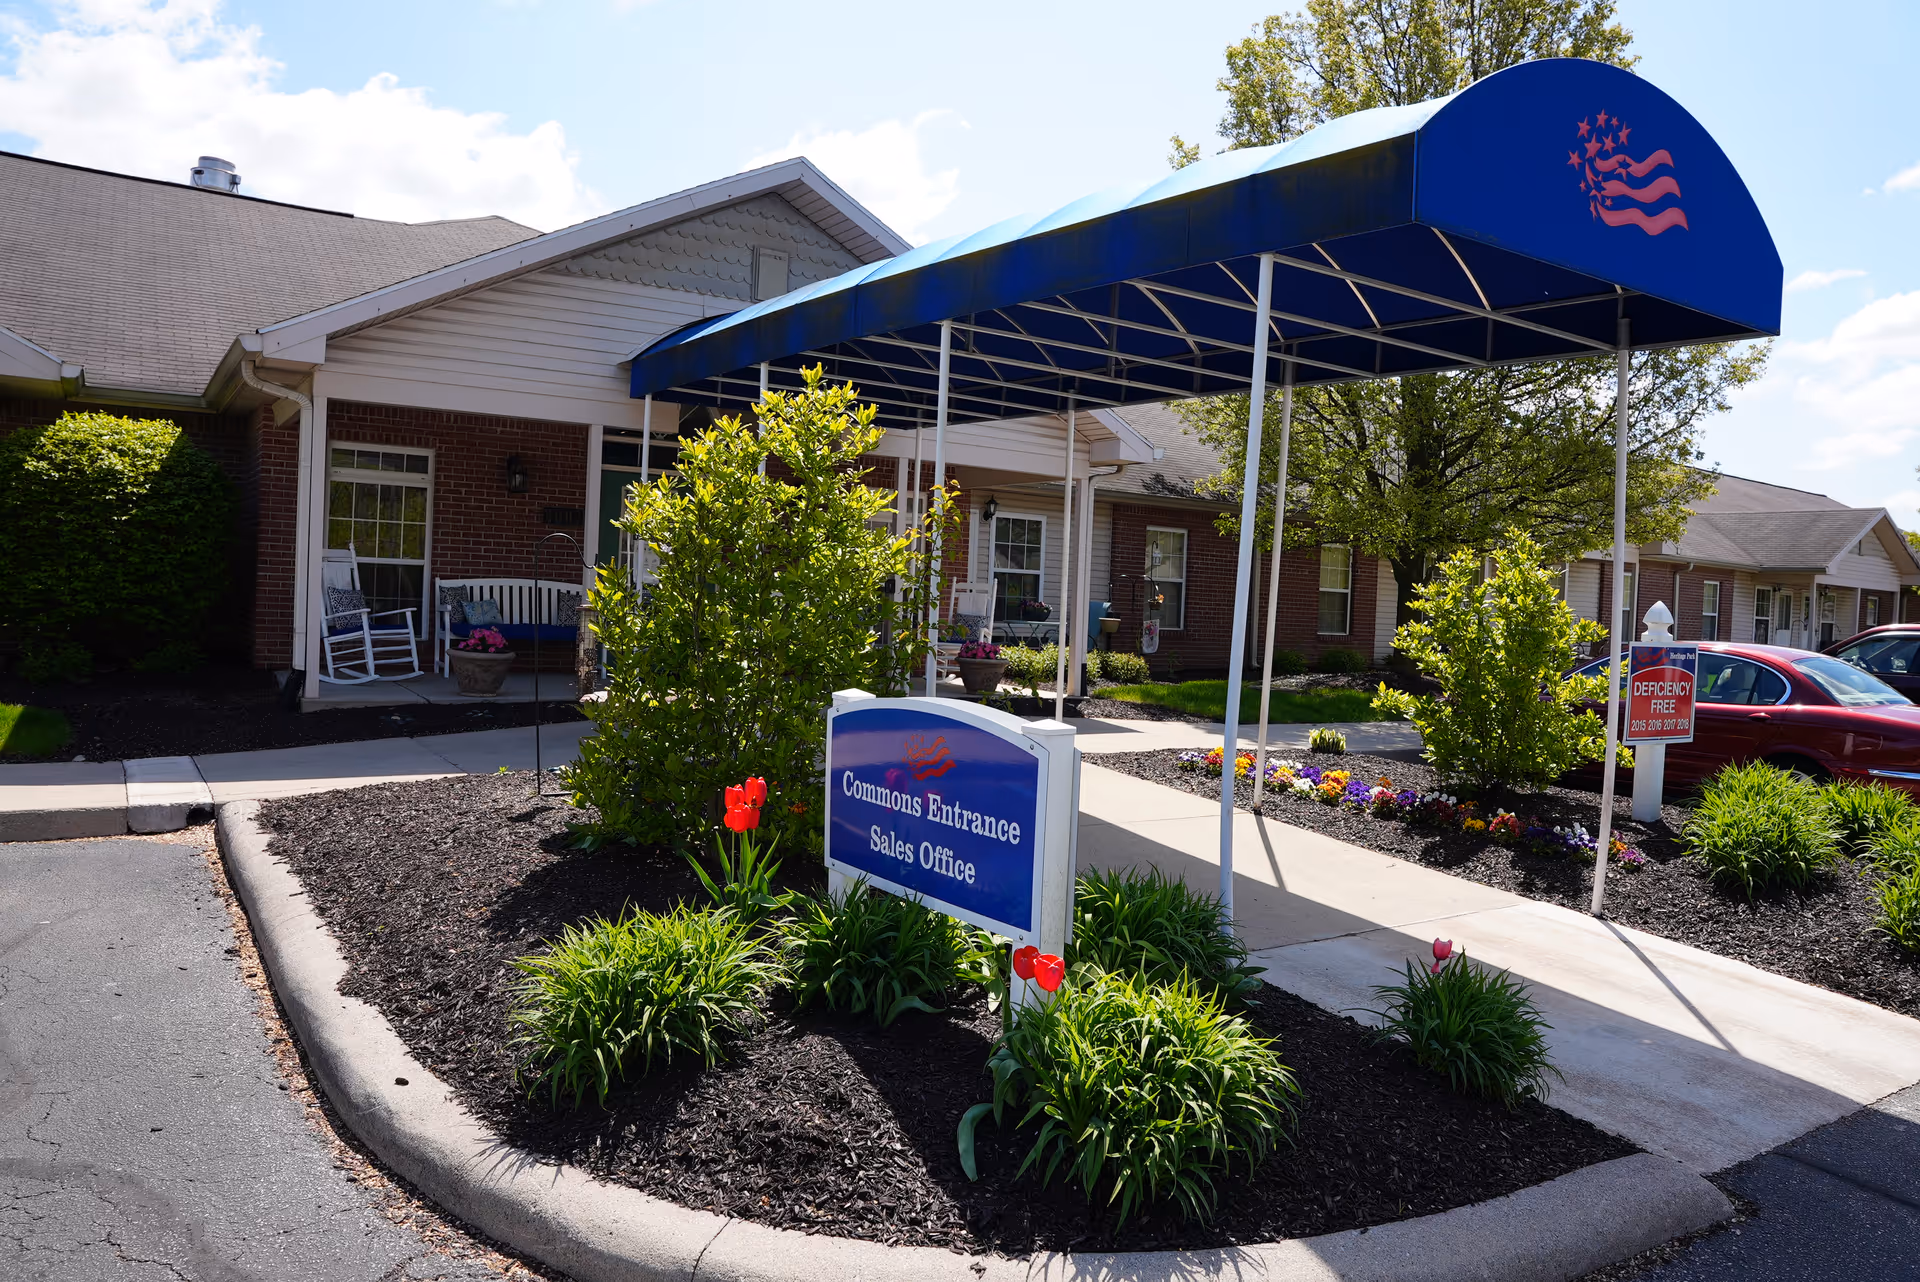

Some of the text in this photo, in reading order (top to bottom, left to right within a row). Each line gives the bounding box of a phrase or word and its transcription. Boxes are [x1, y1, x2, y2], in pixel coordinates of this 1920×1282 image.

[1670, 652, 1695, 660] Heritage Park
[1634, 681, 1691, 696] DEFICIENCY
[1650, 699, 1676, 714] FREE
[1631, 718, 1690, 731] 2015 2016 2017 2018
[842, 770, 1021, 845] Commons Entrance
[870, 824, 976, 884] Sales Office
